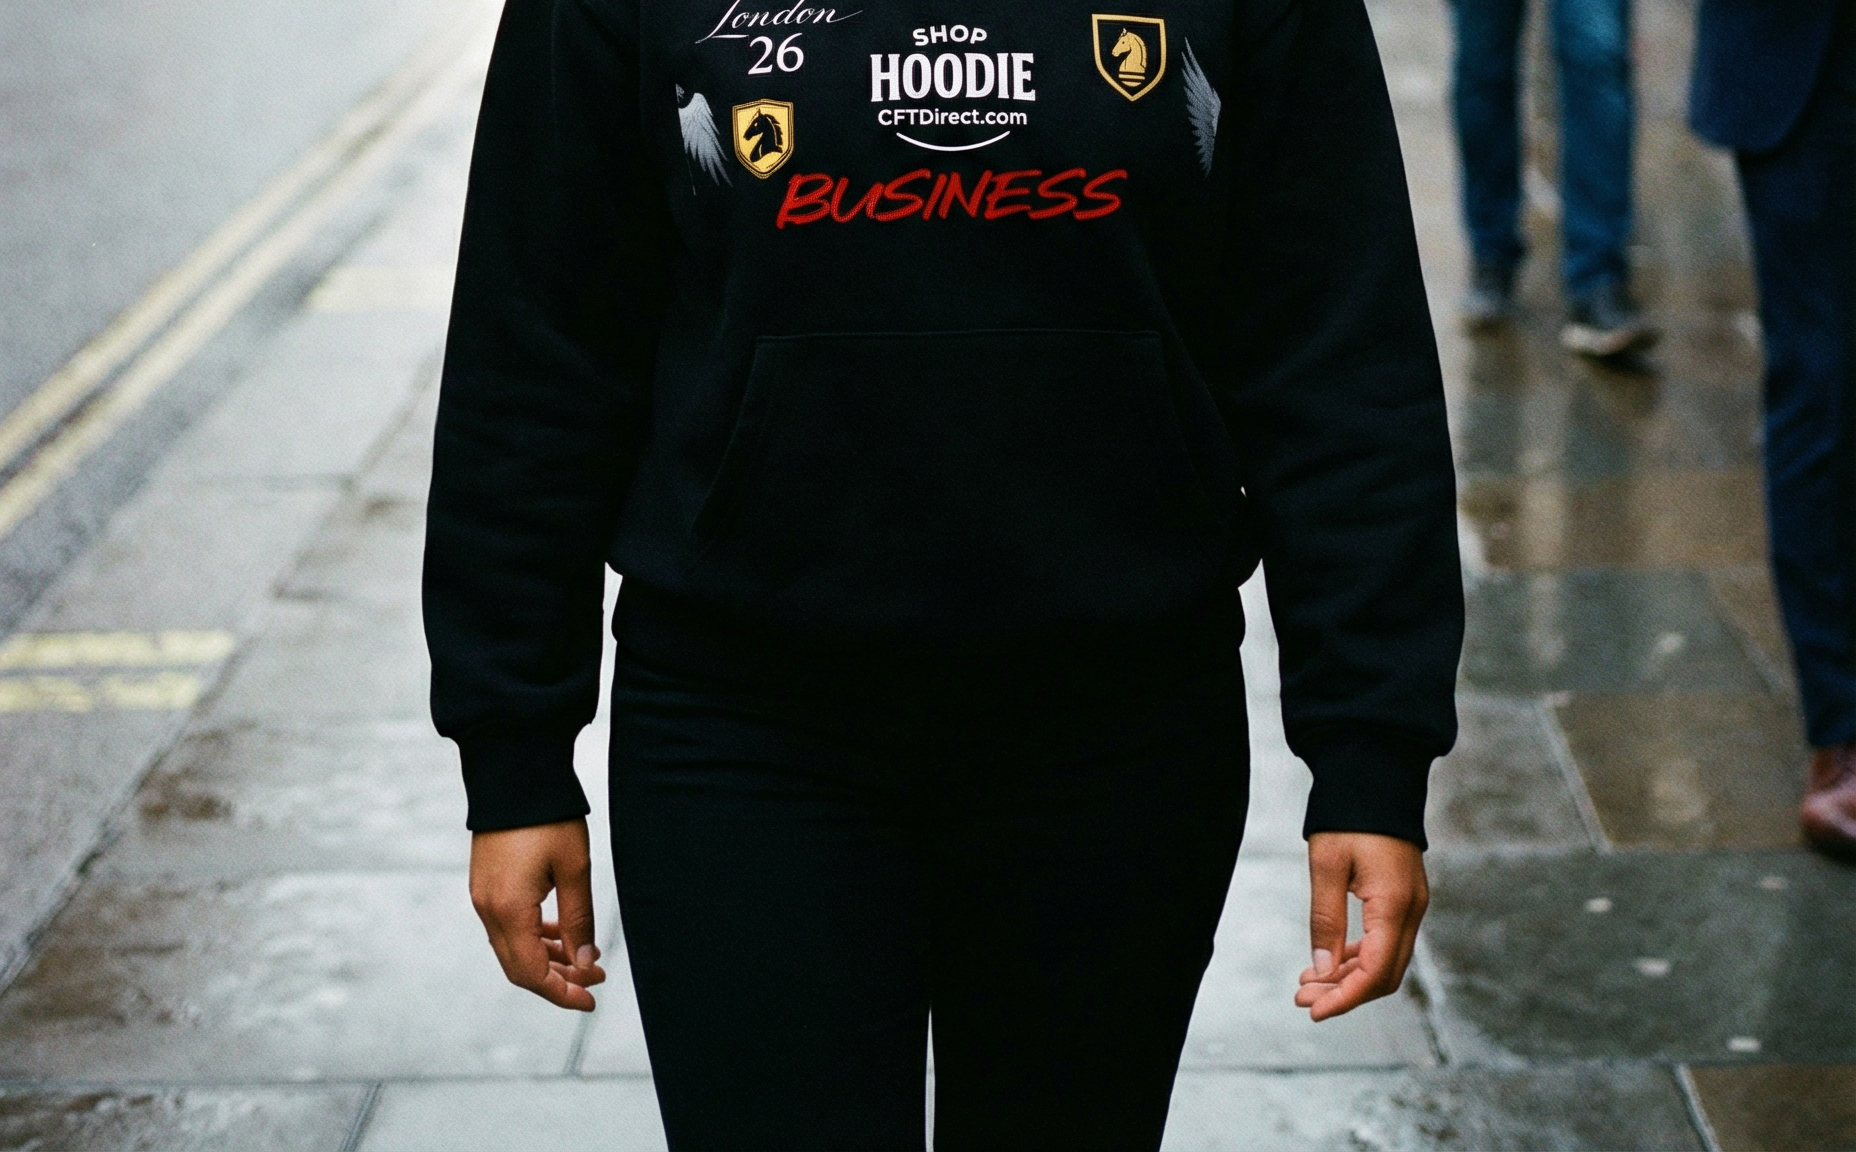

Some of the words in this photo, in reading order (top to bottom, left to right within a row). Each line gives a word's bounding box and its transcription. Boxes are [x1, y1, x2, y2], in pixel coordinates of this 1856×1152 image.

[748, 32, 804, 75] 26
[912, 24, 988, 46] SHOP
[870, 52, 1036, 102] HOODIE
[877, 108, 1028, 126] CFTDirect.com
[776, 168, 1128, 229] BUSINESS
